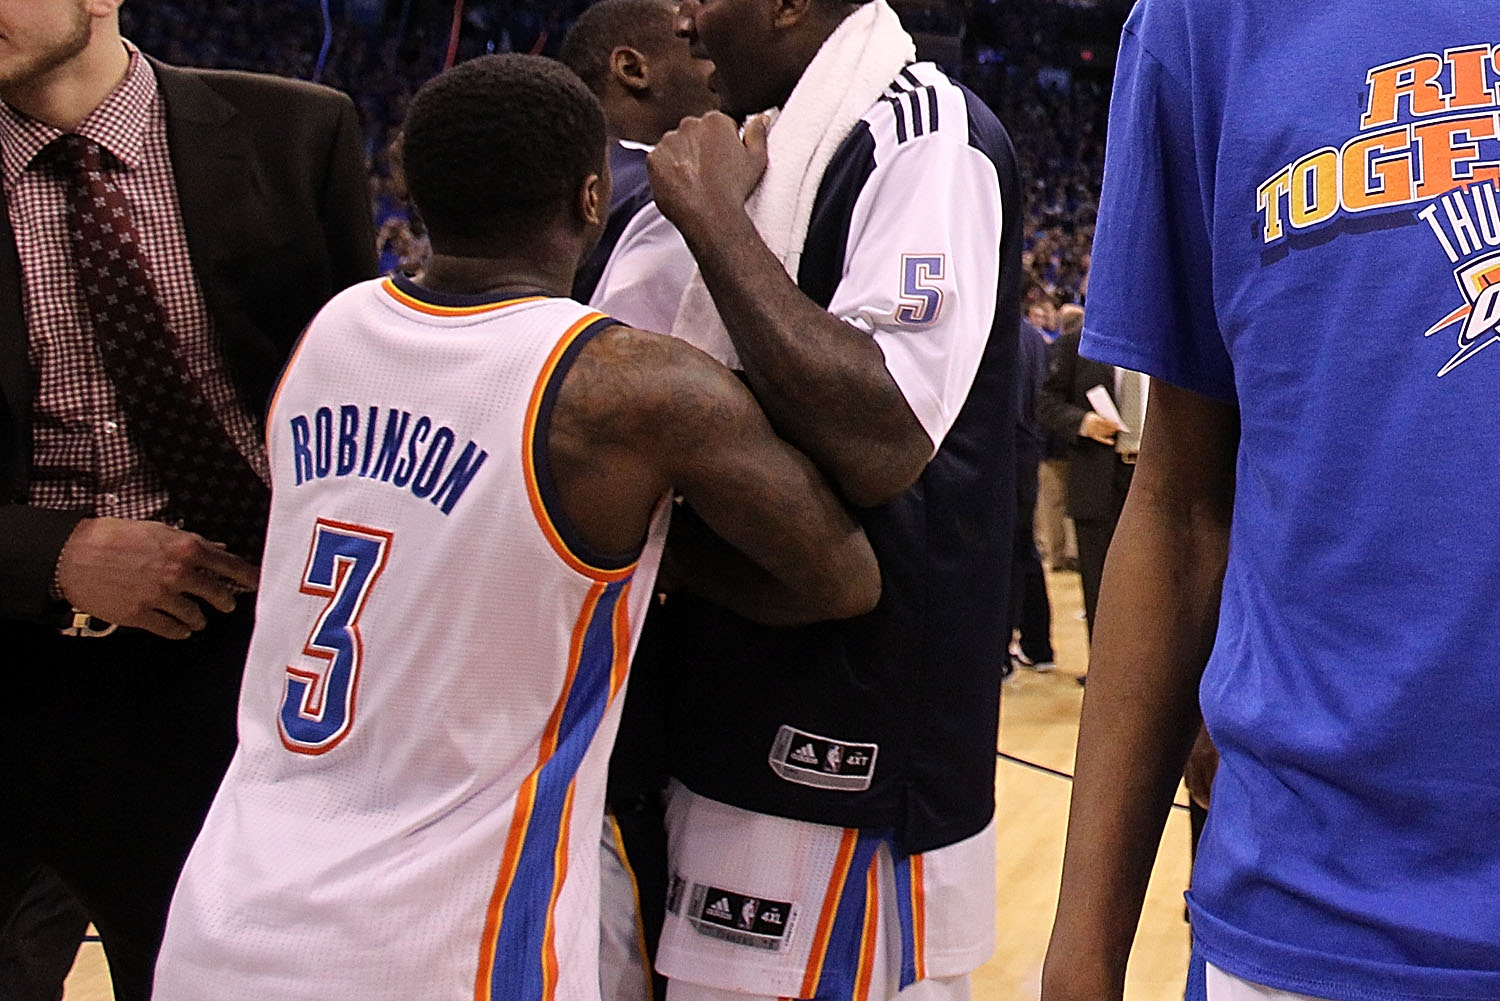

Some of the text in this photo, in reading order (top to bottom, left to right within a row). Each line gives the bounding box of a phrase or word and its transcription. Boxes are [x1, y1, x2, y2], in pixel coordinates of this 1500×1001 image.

[895, 253, 945, 326] 5
[290, 404, 489, 517] ROBINSON
[277, 517, 394, 757] 3
